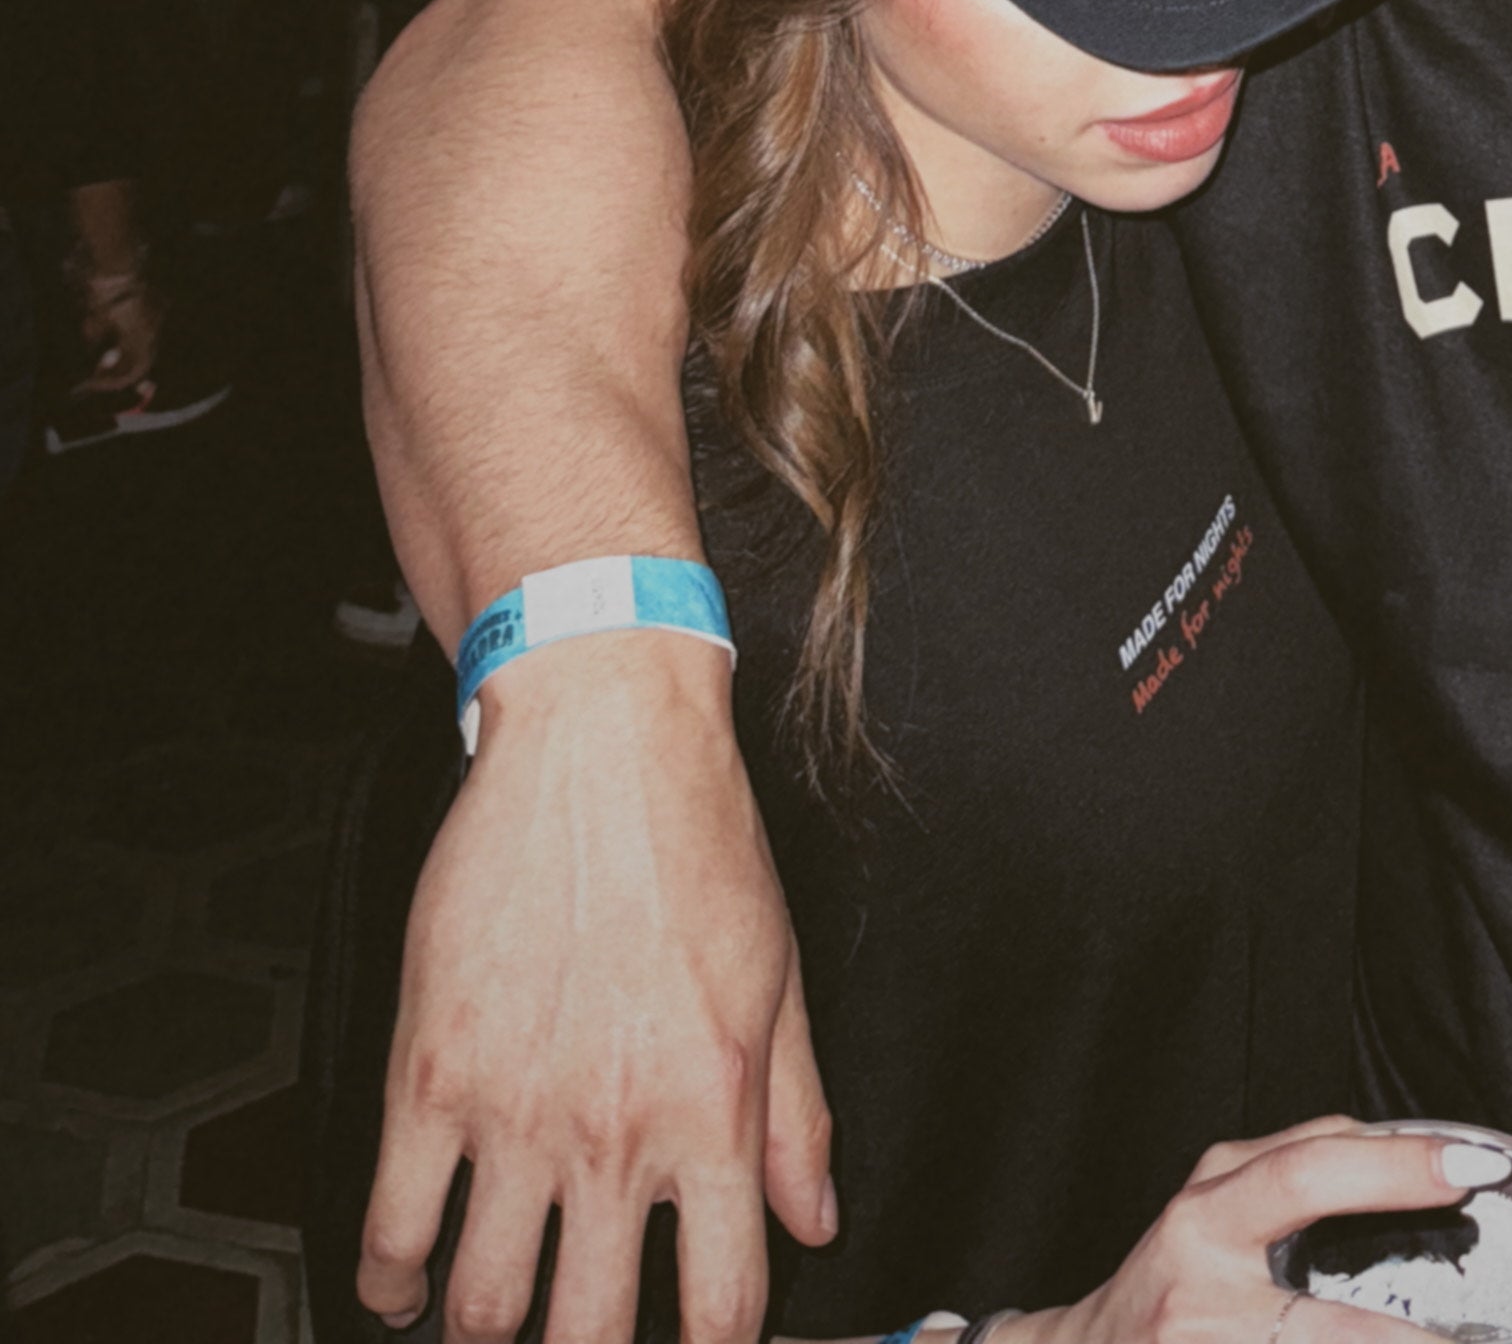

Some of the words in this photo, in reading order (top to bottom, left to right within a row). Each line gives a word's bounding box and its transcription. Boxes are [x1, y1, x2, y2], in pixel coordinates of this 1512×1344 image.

[1119, 600, 1167, 670] MADE
[1163, 561, 1197, 614] FOR
[1193, 494, 1236, 574] NIGHTS
[1131, 645, 1184, 714] Made
[1180, 599, 1210, 650] for
[1211, 525, 1254, 602] nights
